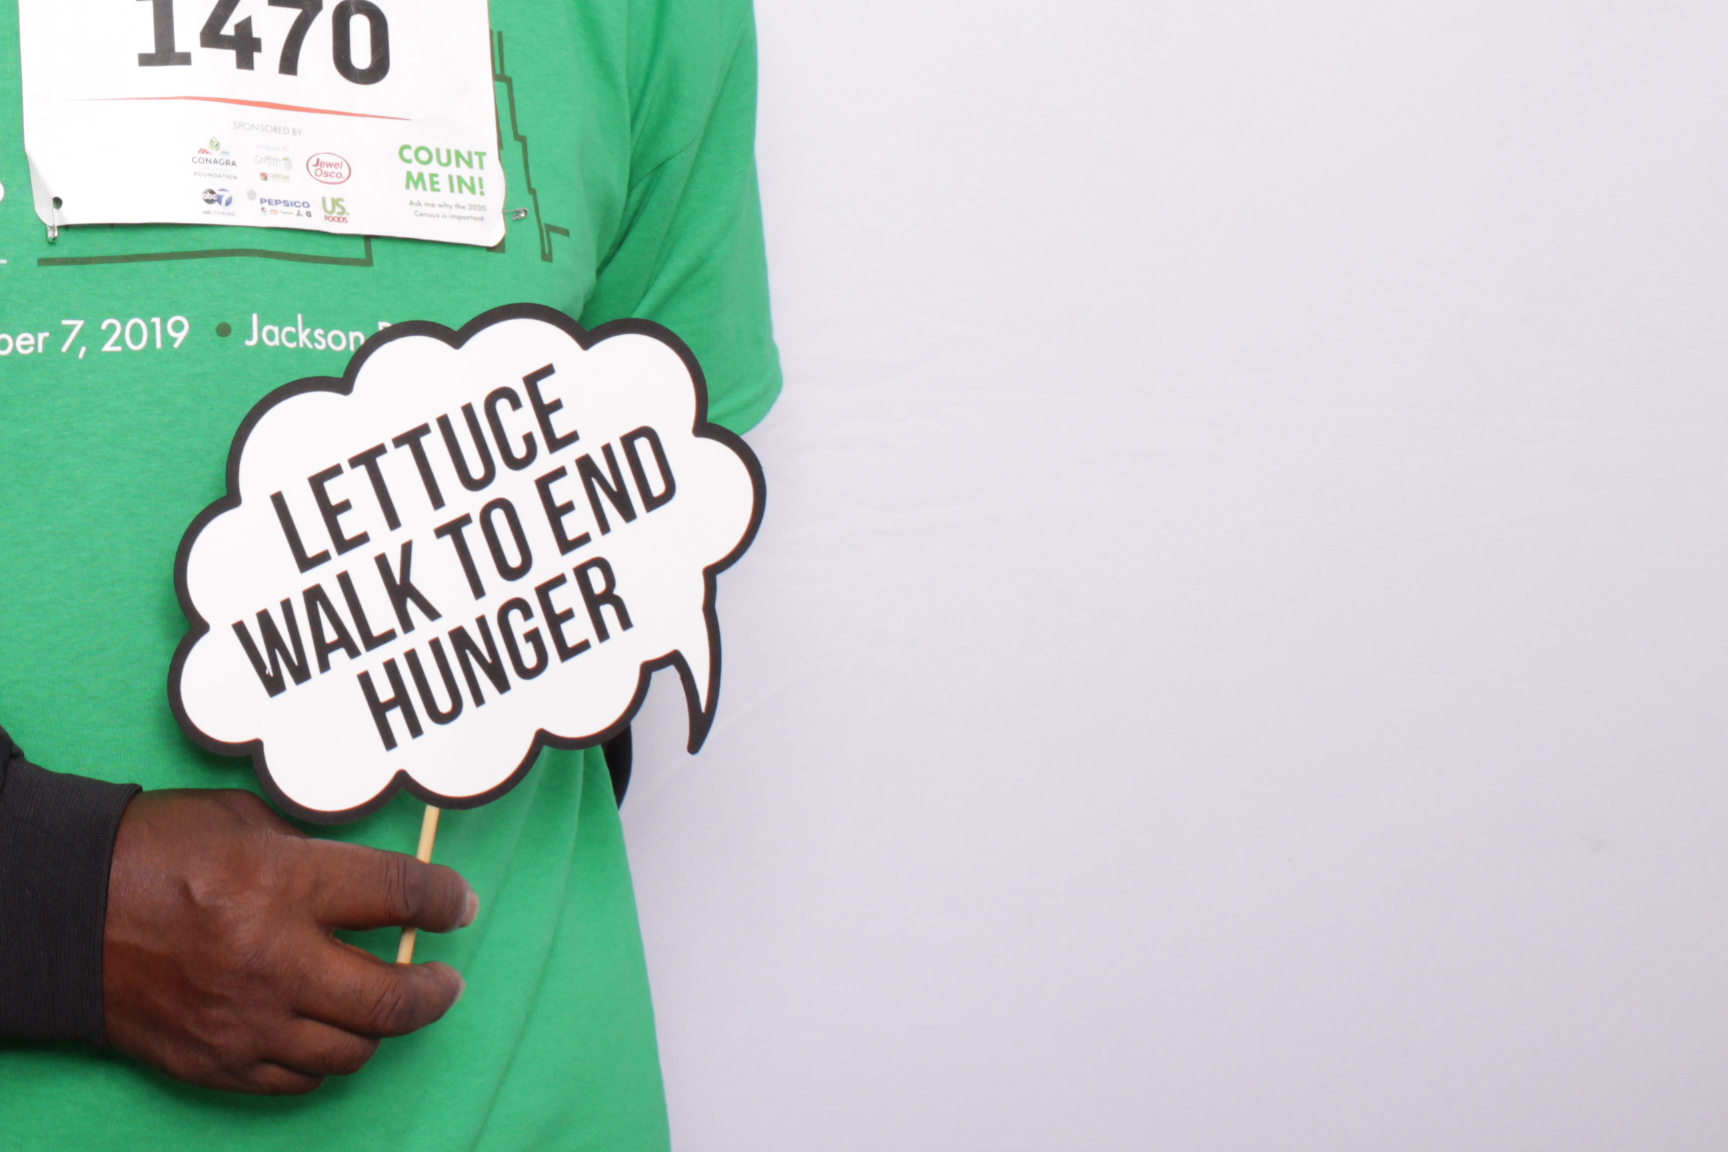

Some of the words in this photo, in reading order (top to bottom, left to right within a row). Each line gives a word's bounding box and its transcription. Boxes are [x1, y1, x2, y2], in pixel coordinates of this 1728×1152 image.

[233, 121, 290, 135] SPONSORED
[191, 156, 237, 167] CONAGRA
[255, 154, 282, 169] Griffith
[312, 157, 343, 171] Jewel
[398, 144, 487, 170] COUNT
[193, 171, 238, 179] FOUNDATION
[405, 171, 441, 193] ME
[448, 174, 485, 196] IN!
[260, 198, 310, 209] PEPSICO
[409, 199, 422, 207] Ask
[437, 202, 453, 211] why
[455, 202, 466, 210] the
[468, 204, 487, 212] 2020
[324, 214, 348, 224] FOODS
[414, 210, 440, 219] Census
[448, 212, 484, 222] important
[60, 319, 86, 359] 7,
[100, 315, 190, 352] 2019
[244, 313, 365, 351] Jackson
[269, 363, 580, 574] LETTUCE
[231, 539, 443, 698] WALK
[433, 497, 534, 601] TO
[533, 424, 677, 556] END
[357, 556, 634, 752] HUNGER
